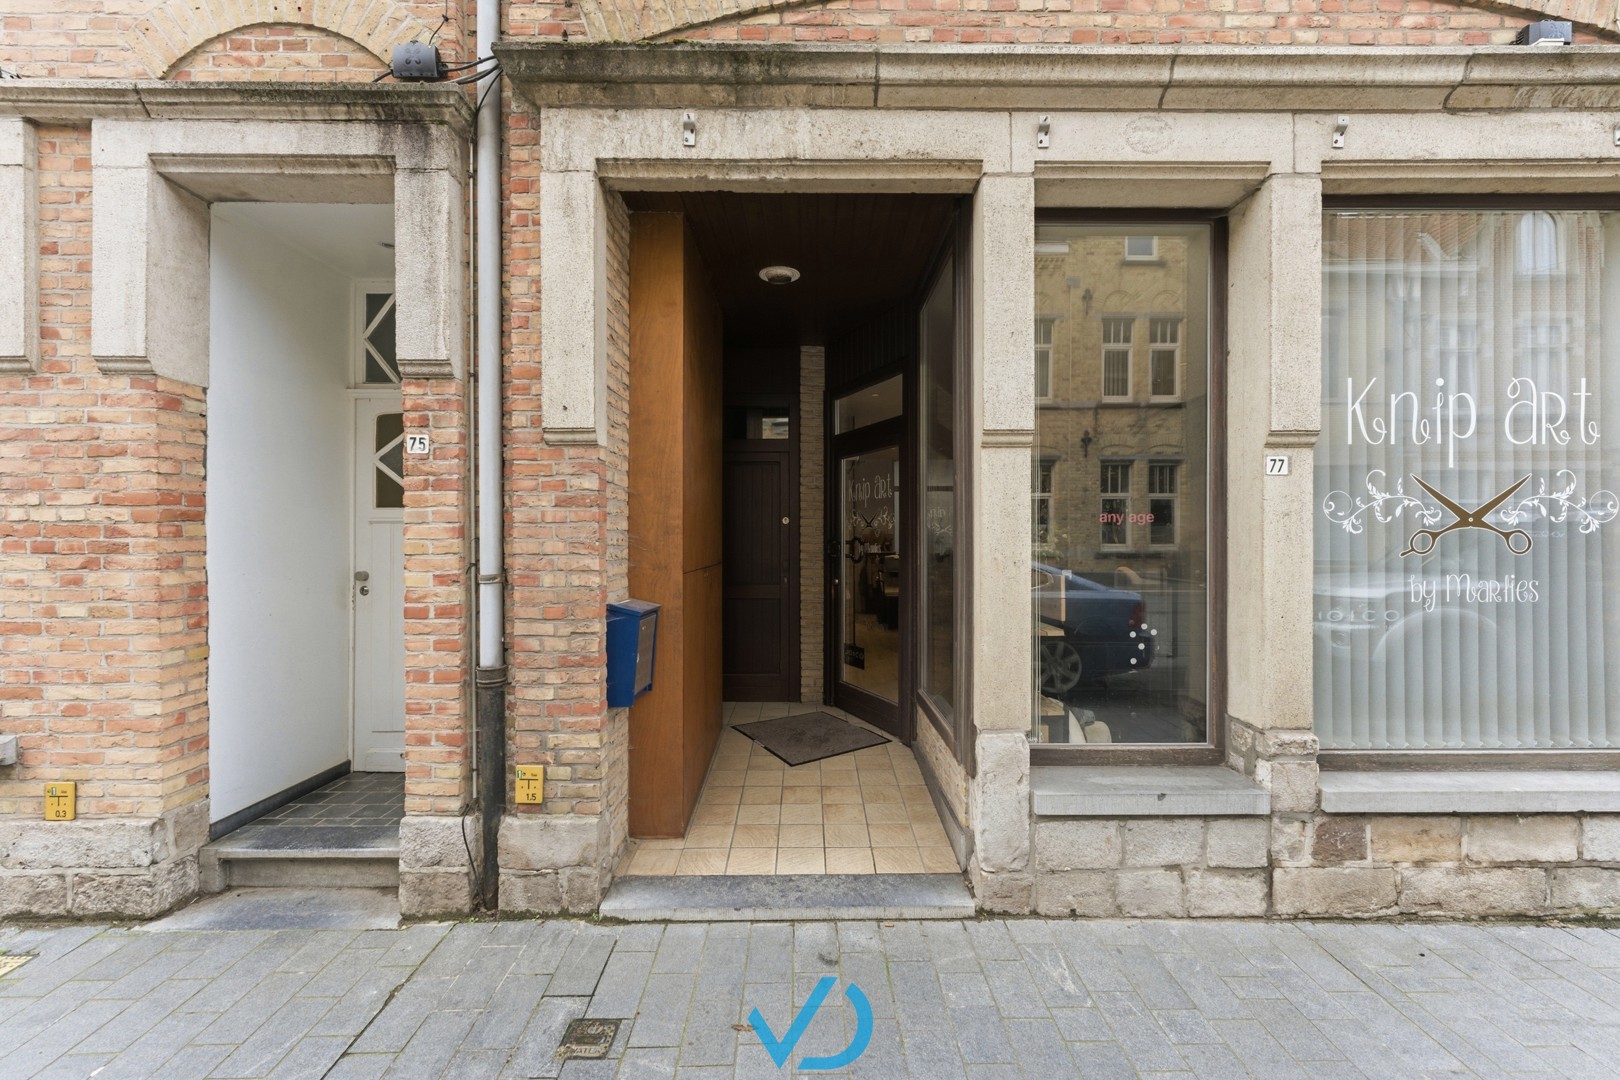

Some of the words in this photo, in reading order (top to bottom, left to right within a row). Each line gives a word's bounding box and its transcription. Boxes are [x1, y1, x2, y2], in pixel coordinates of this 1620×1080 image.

[1347, 376, 1477, 468] Knip
[409, 436, 427, 451] 75
[1269, 458, 1285, 473] 77
[1099, 513, 1125, 526] any
[1129, 513, 1155, 526] age
[1407, 574, 1436, 613] by
